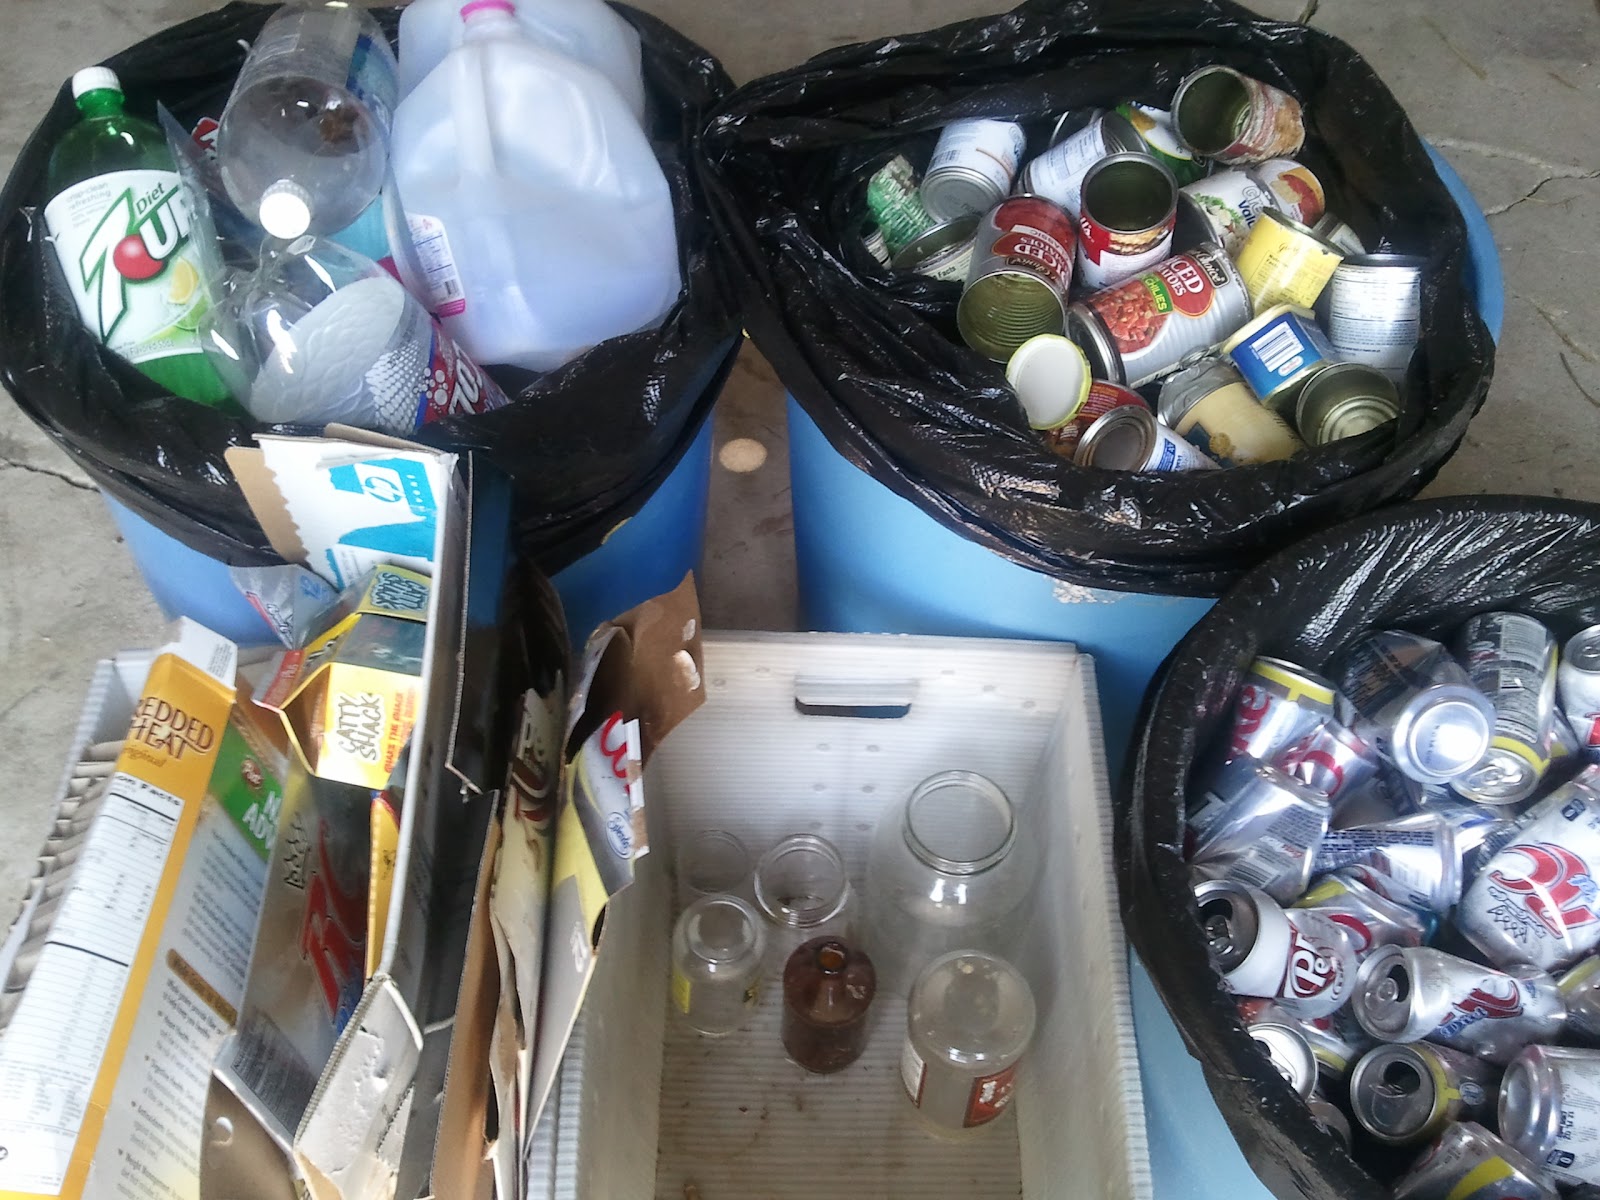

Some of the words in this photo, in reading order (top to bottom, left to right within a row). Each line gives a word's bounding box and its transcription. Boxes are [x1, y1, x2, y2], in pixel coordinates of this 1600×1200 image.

[136, 182, 164, 215] Diet
[937, 265, 957, 280] Facts
[337, 696, 358, 754] CATTY
[359, 694, 382, 761] SHACK
[1489, 841, 1600, 940] RC
